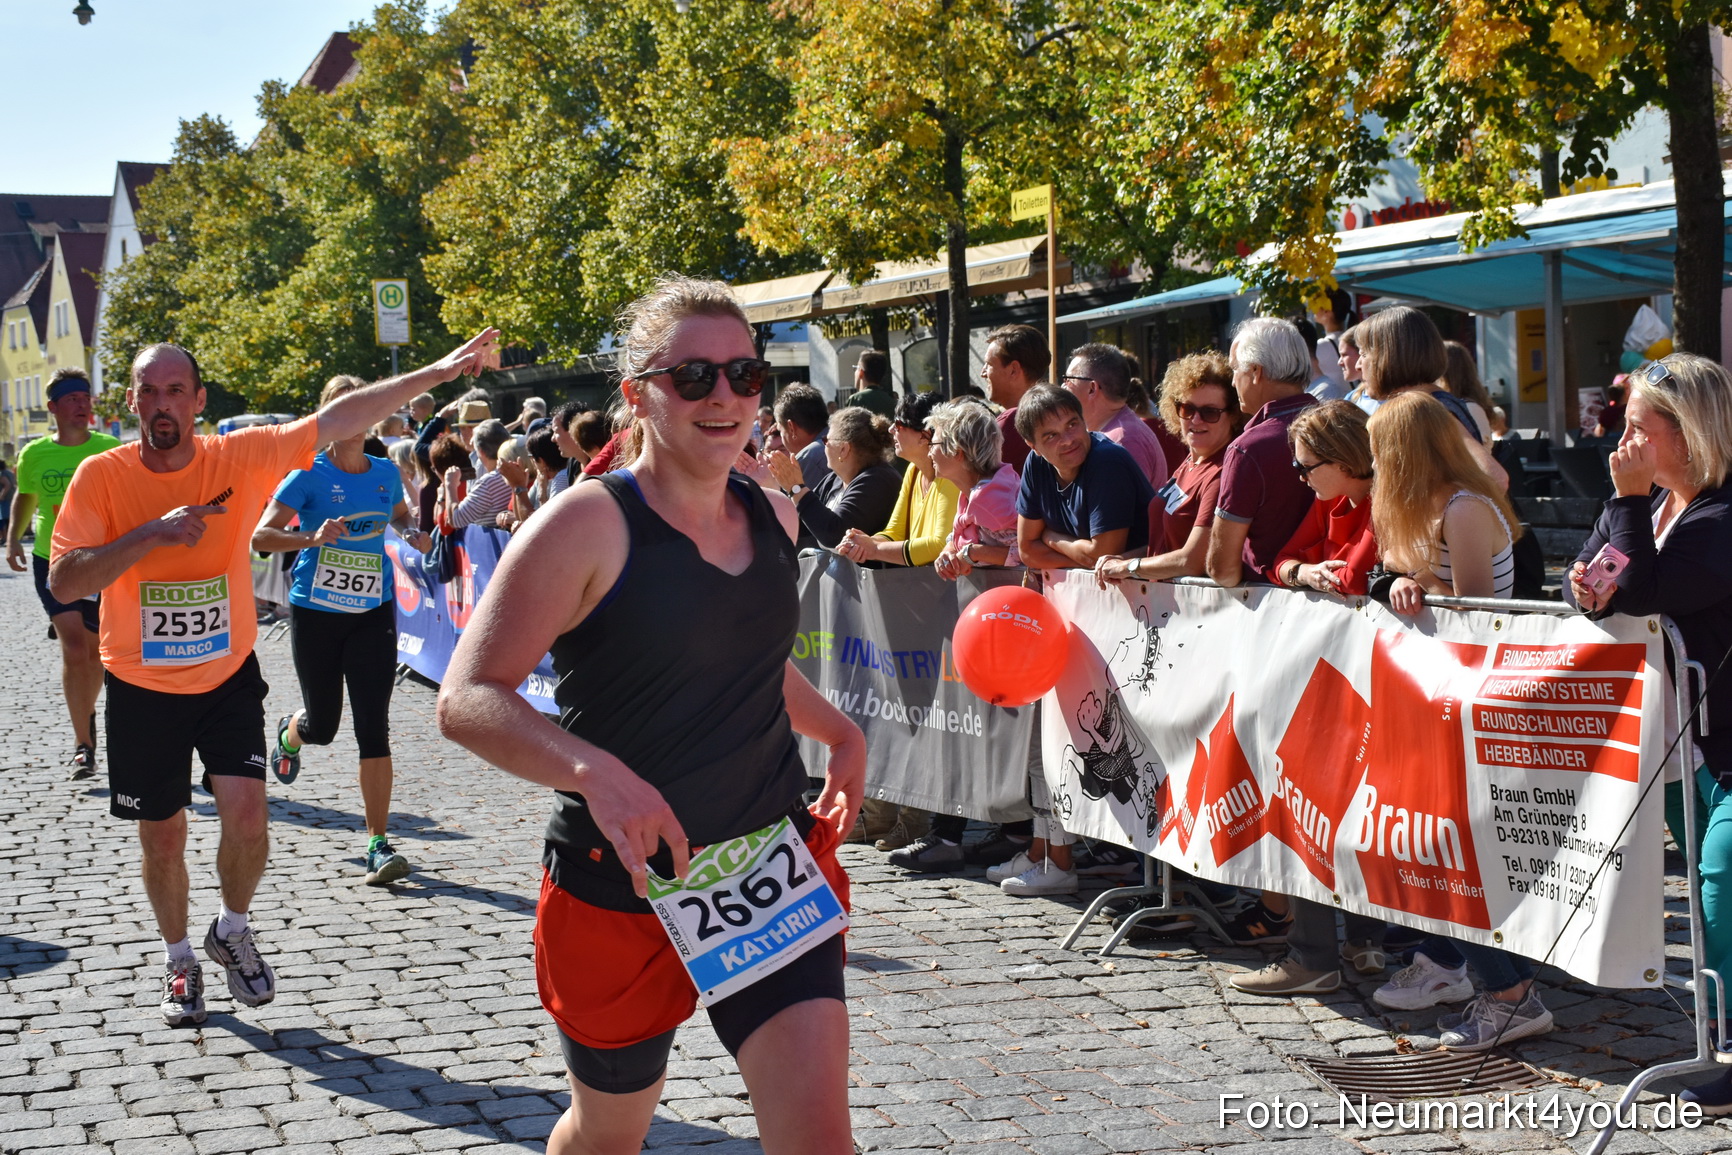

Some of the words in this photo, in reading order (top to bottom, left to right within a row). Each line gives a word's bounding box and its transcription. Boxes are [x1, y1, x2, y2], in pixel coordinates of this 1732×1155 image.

[1018, 196, 1048, 211] Toiletten
[324, 549, 379, 571] BOCK
[147, 580, 223, 604] BOCK
[322, 569, 377, 594] 2367
[327, 592, 367, 607] NICOLE
[152, 606, 221, 637] 2532
[164, 640, 213, 656] MARCO
[1501, 648, 1577, 668] BINDESTRICKE
[1484, 679, 1615, 701] VERZURRSYSTEME
[1480, 710, 1608, 736] RUNDSCHLINGEN
[250, 753, 265, 765] JAKO
[1484, 744, 1588, 768] HEBEBÄNDER
[117, 793, 140, 811] MDC
[1272, 759, 1331, 854] Braun
[1490, 784, 1530, 804] Braun
[1533, 787, 1577, 807] GmbH
[1203, 778, 1259, 841] Braun
[1494, 805, 1515, 823] Am
[1517, 807, 1578, 833] Grünberg
[1581, 813, 1587, 831] 8
[1227, 823, 1246, 838] Sicher
[1244, 815, 1255, 827] ist
[1354, 783, 1466, 872] Braun
[1496, 826, 1550, 846] D-92318
[1502, 855, 1527, 872] Tel.
[1529, 858, 1560, 879] 09181
[677, 843, 808, 942] 2662
[1398, 868, 1431, 889] Sicher
[1433, 875, 1449, 892] ist
[1450, 879, 1484, 898] sicher
[1508, 876, 1531, 894] Fax
[1533, 879, 1560, 902] 09181
[719, 900, 822, 973] KATHRIN
